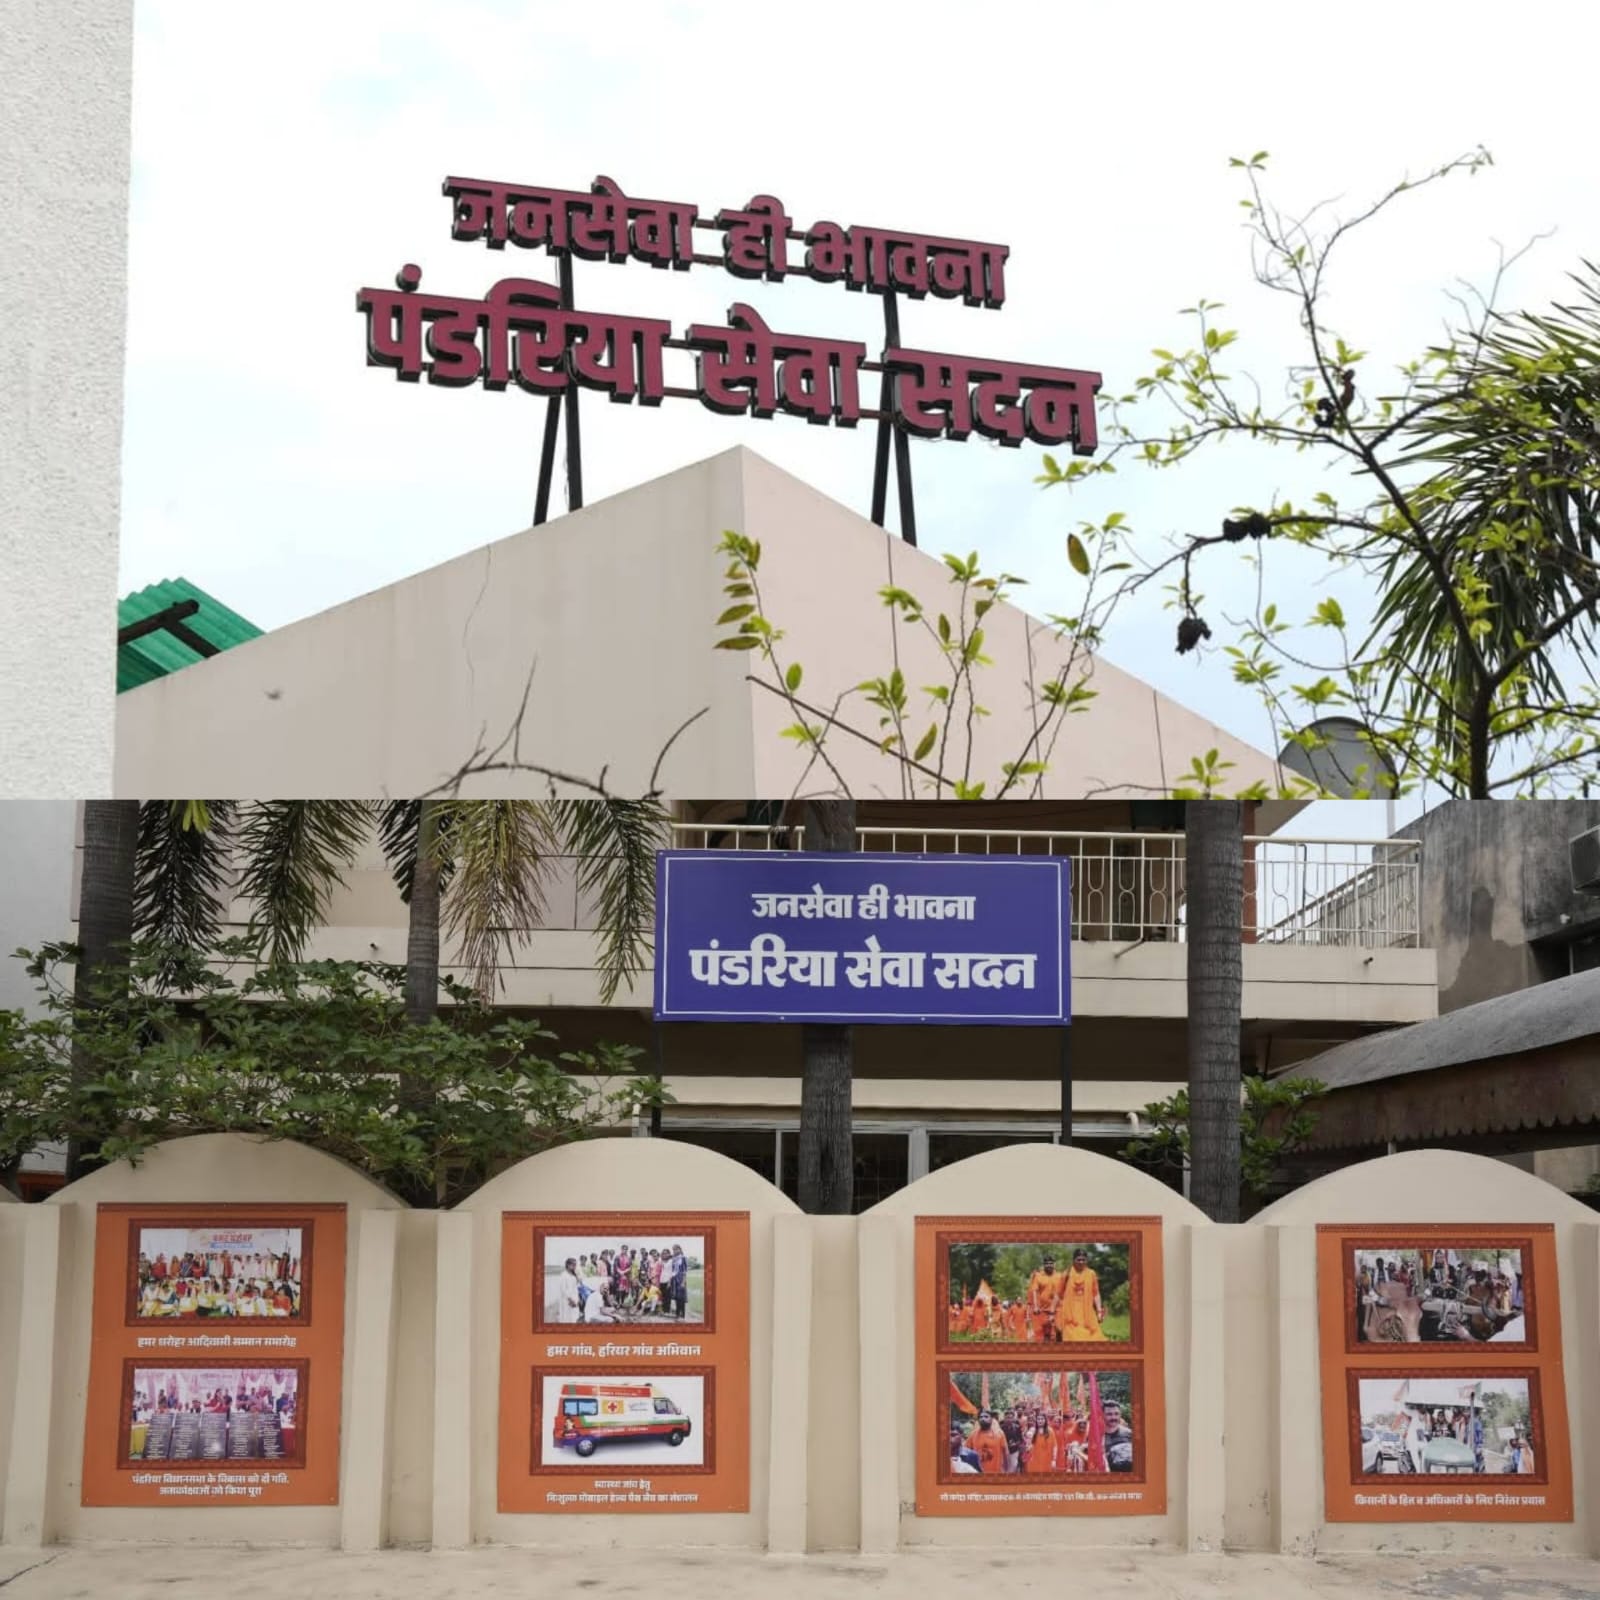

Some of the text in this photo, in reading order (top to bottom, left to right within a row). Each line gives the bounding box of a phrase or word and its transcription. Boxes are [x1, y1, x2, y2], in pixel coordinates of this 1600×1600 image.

[442, 175, 1010, 309] जनसेवा ही भावना
[356, 264, 1102, 457] पंडरिया सेवा सदन
[751, 883, 977, 921] जनसेवा ही भावना
[688, 932, 1038, 990] पंडरिया सेवा सदन
[137, 1336, 157, 1348] हमर
[546, 1344, 570, 1358] हमर
[631, 1342, 655, 1357] गांव
